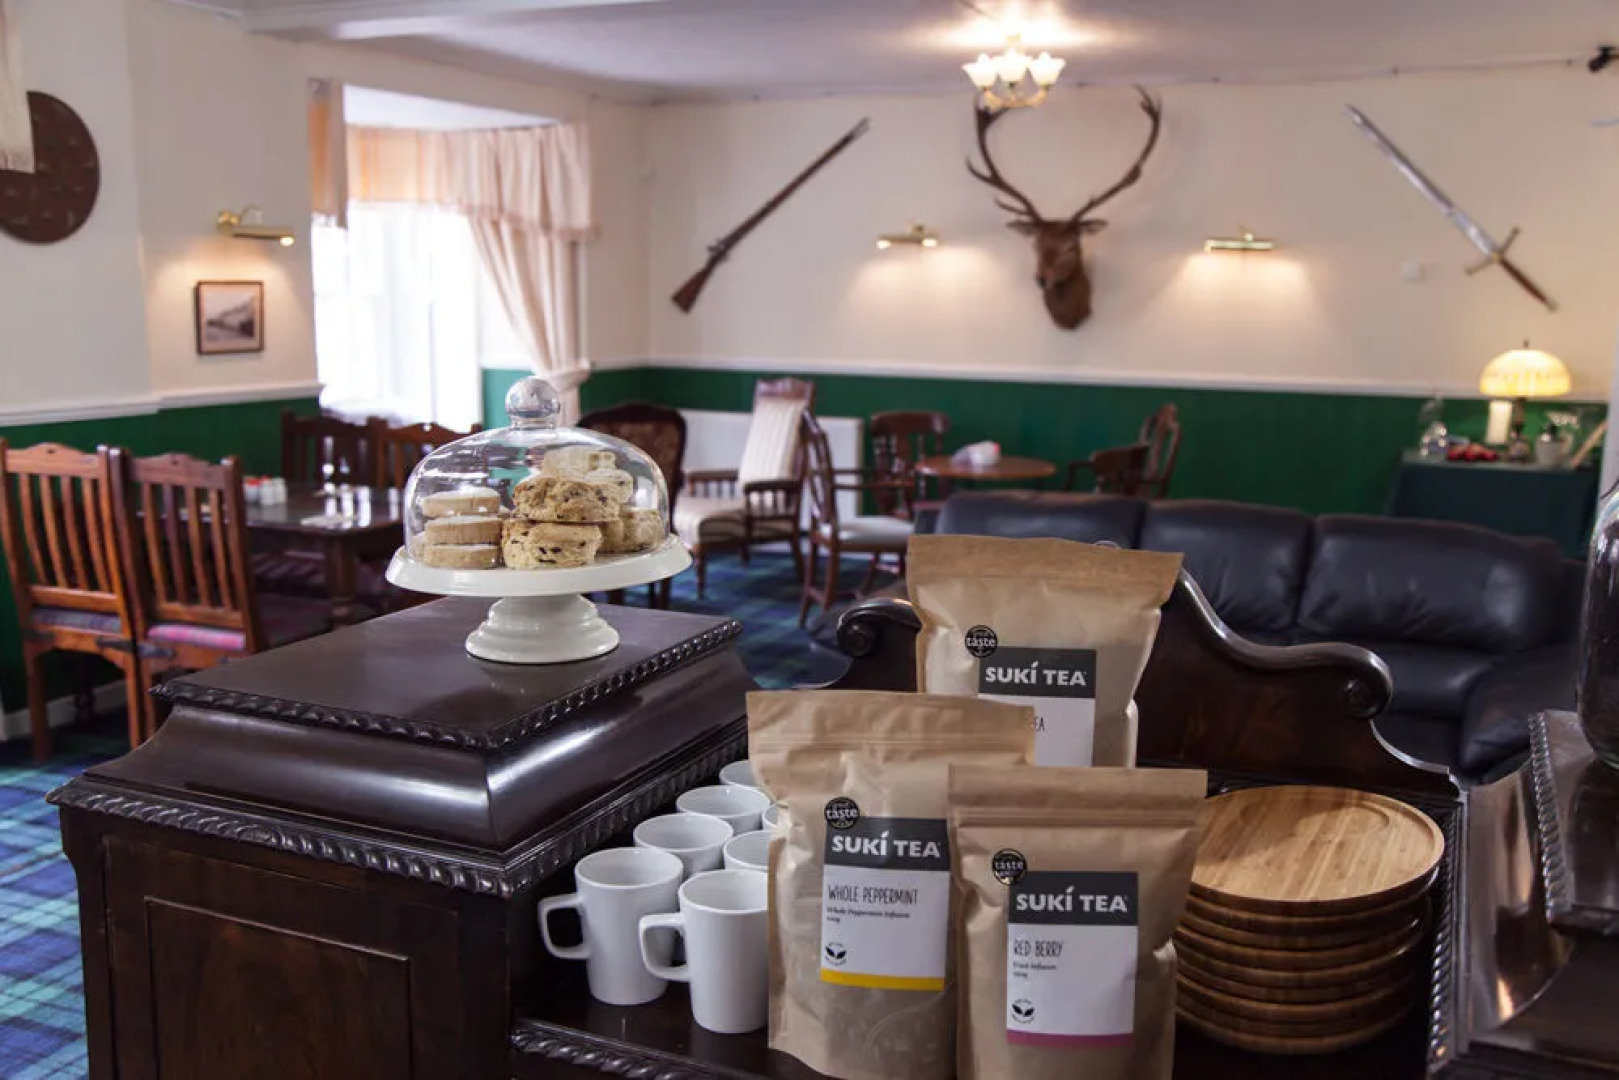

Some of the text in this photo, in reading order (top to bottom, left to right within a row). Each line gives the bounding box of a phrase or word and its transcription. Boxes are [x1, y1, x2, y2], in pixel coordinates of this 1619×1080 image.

[985, 660, 1086, 686] SUKÍ TEA
[1034, 716, 1045, 733] EA
[831, 830, 940, 858] SUKÍ TEA
[828, 885, 918, 905] WHOLE PEPPERMINT
[1016, 885, 1128, 913] SUKÍ TEA
[1014, 939, 1063, 958] RED BERRY
